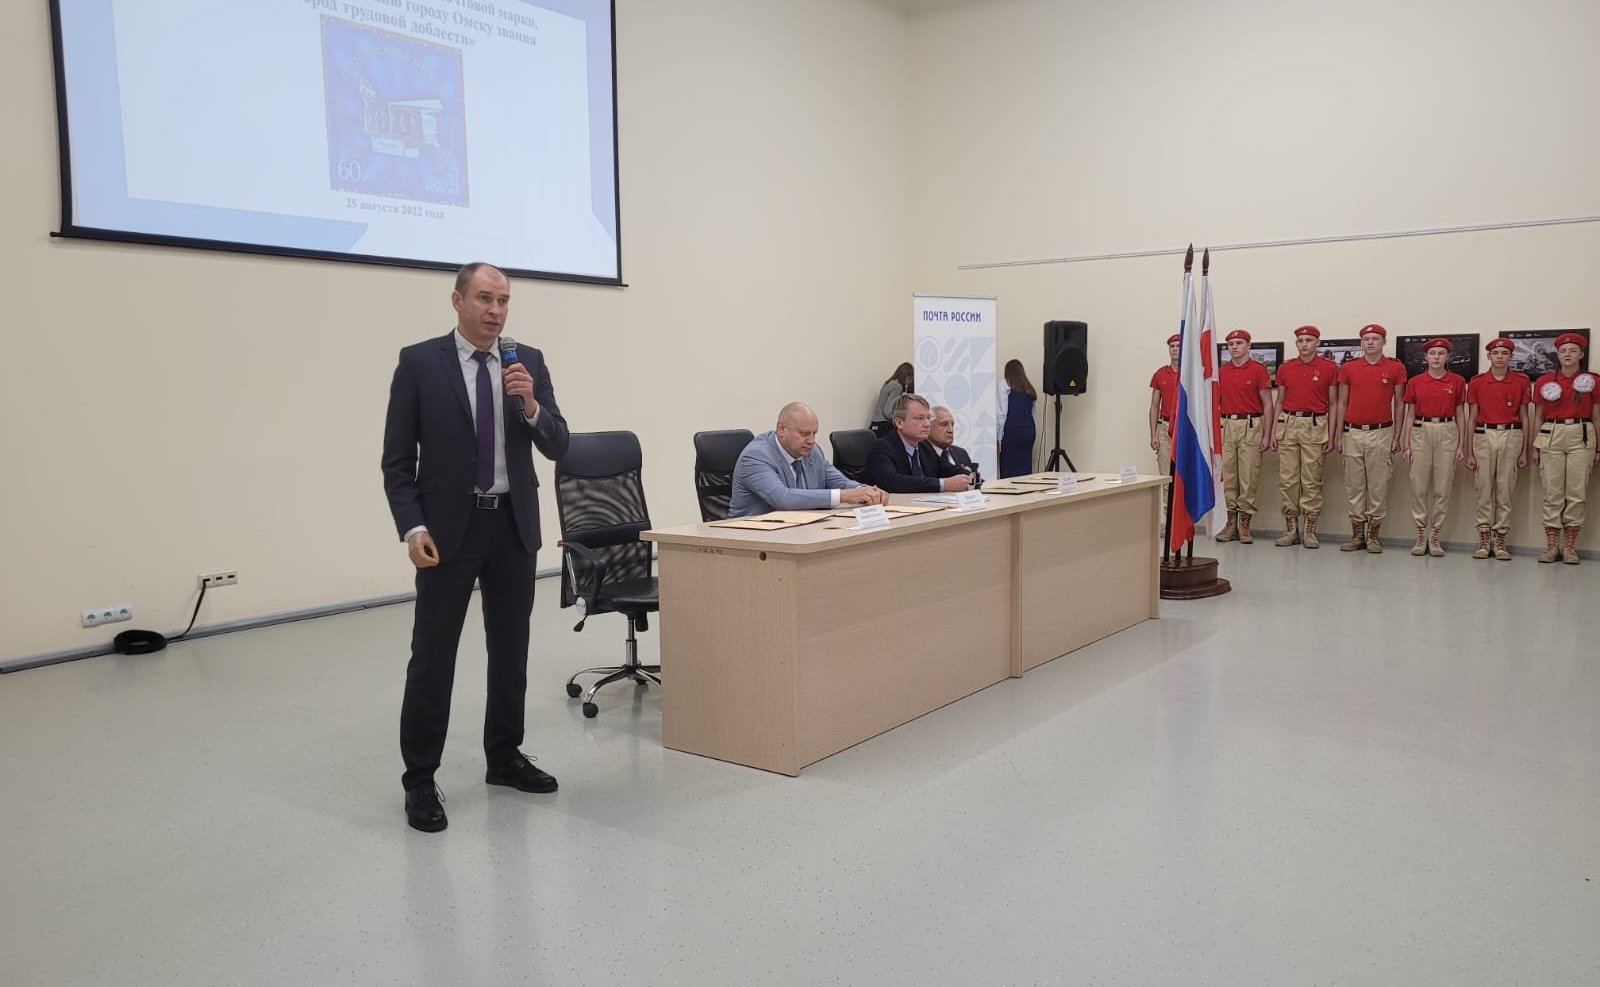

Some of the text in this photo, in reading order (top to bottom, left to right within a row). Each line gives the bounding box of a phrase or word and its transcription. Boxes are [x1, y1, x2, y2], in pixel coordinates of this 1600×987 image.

[341, 2, 408, 30] трудовой
[410, 20, 476, 47] доблести»
[406, 1, 449, 24] городу
[452, 10, 494, 37] Омску
[497, 26, 537, 46] звания
[498, 8, 539, 30] марки,
[345, 197, 358, 208] 25
[360, 202, 399, 214] августа
[400, 204, 423, 217] 2022
[923, 310, 982, 322] ПОЧТА РОССИИ
